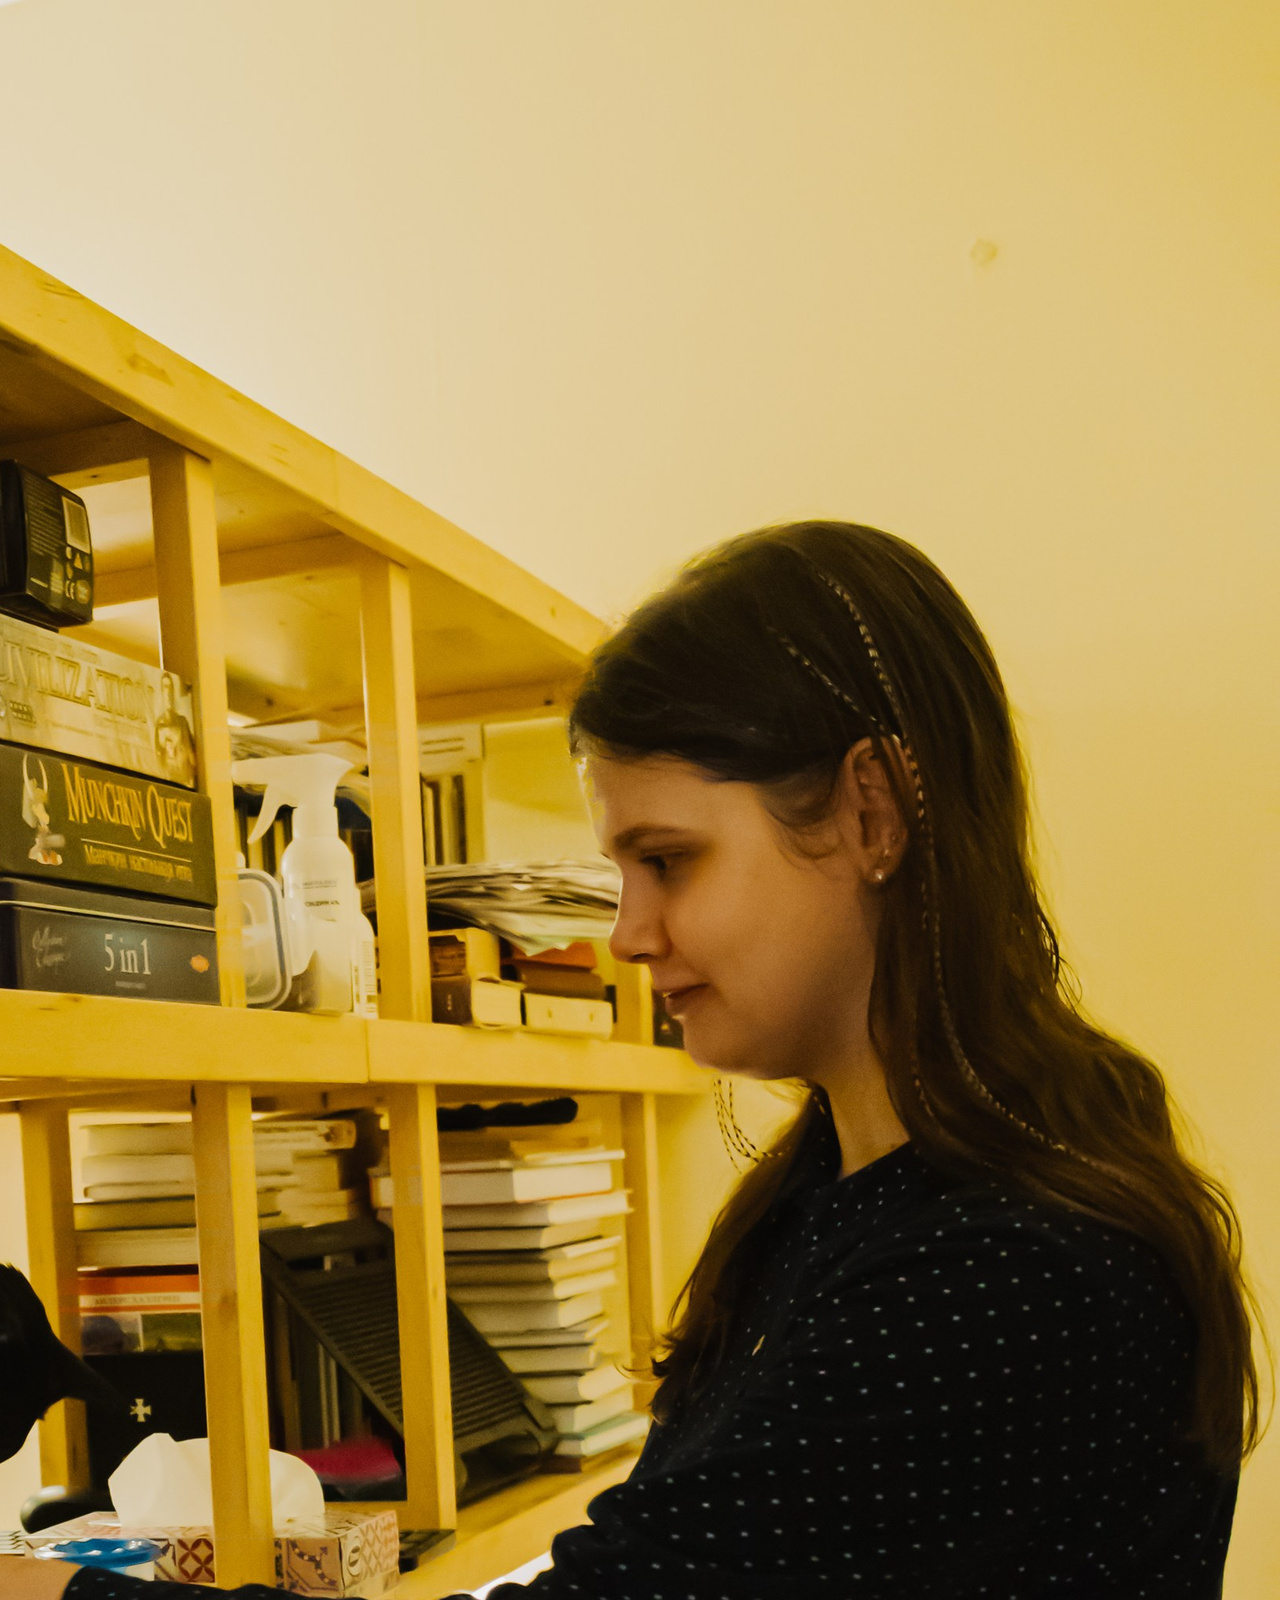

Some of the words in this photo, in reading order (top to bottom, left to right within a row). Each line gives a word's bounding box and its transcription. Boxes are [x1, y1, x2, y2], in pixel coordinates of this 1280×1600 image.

[147, 785, 193, 849] QUEST
[104, 933, 115, 973] 5
[120, 937, 140, 974] in
[140, 937, 152, 975] 1
